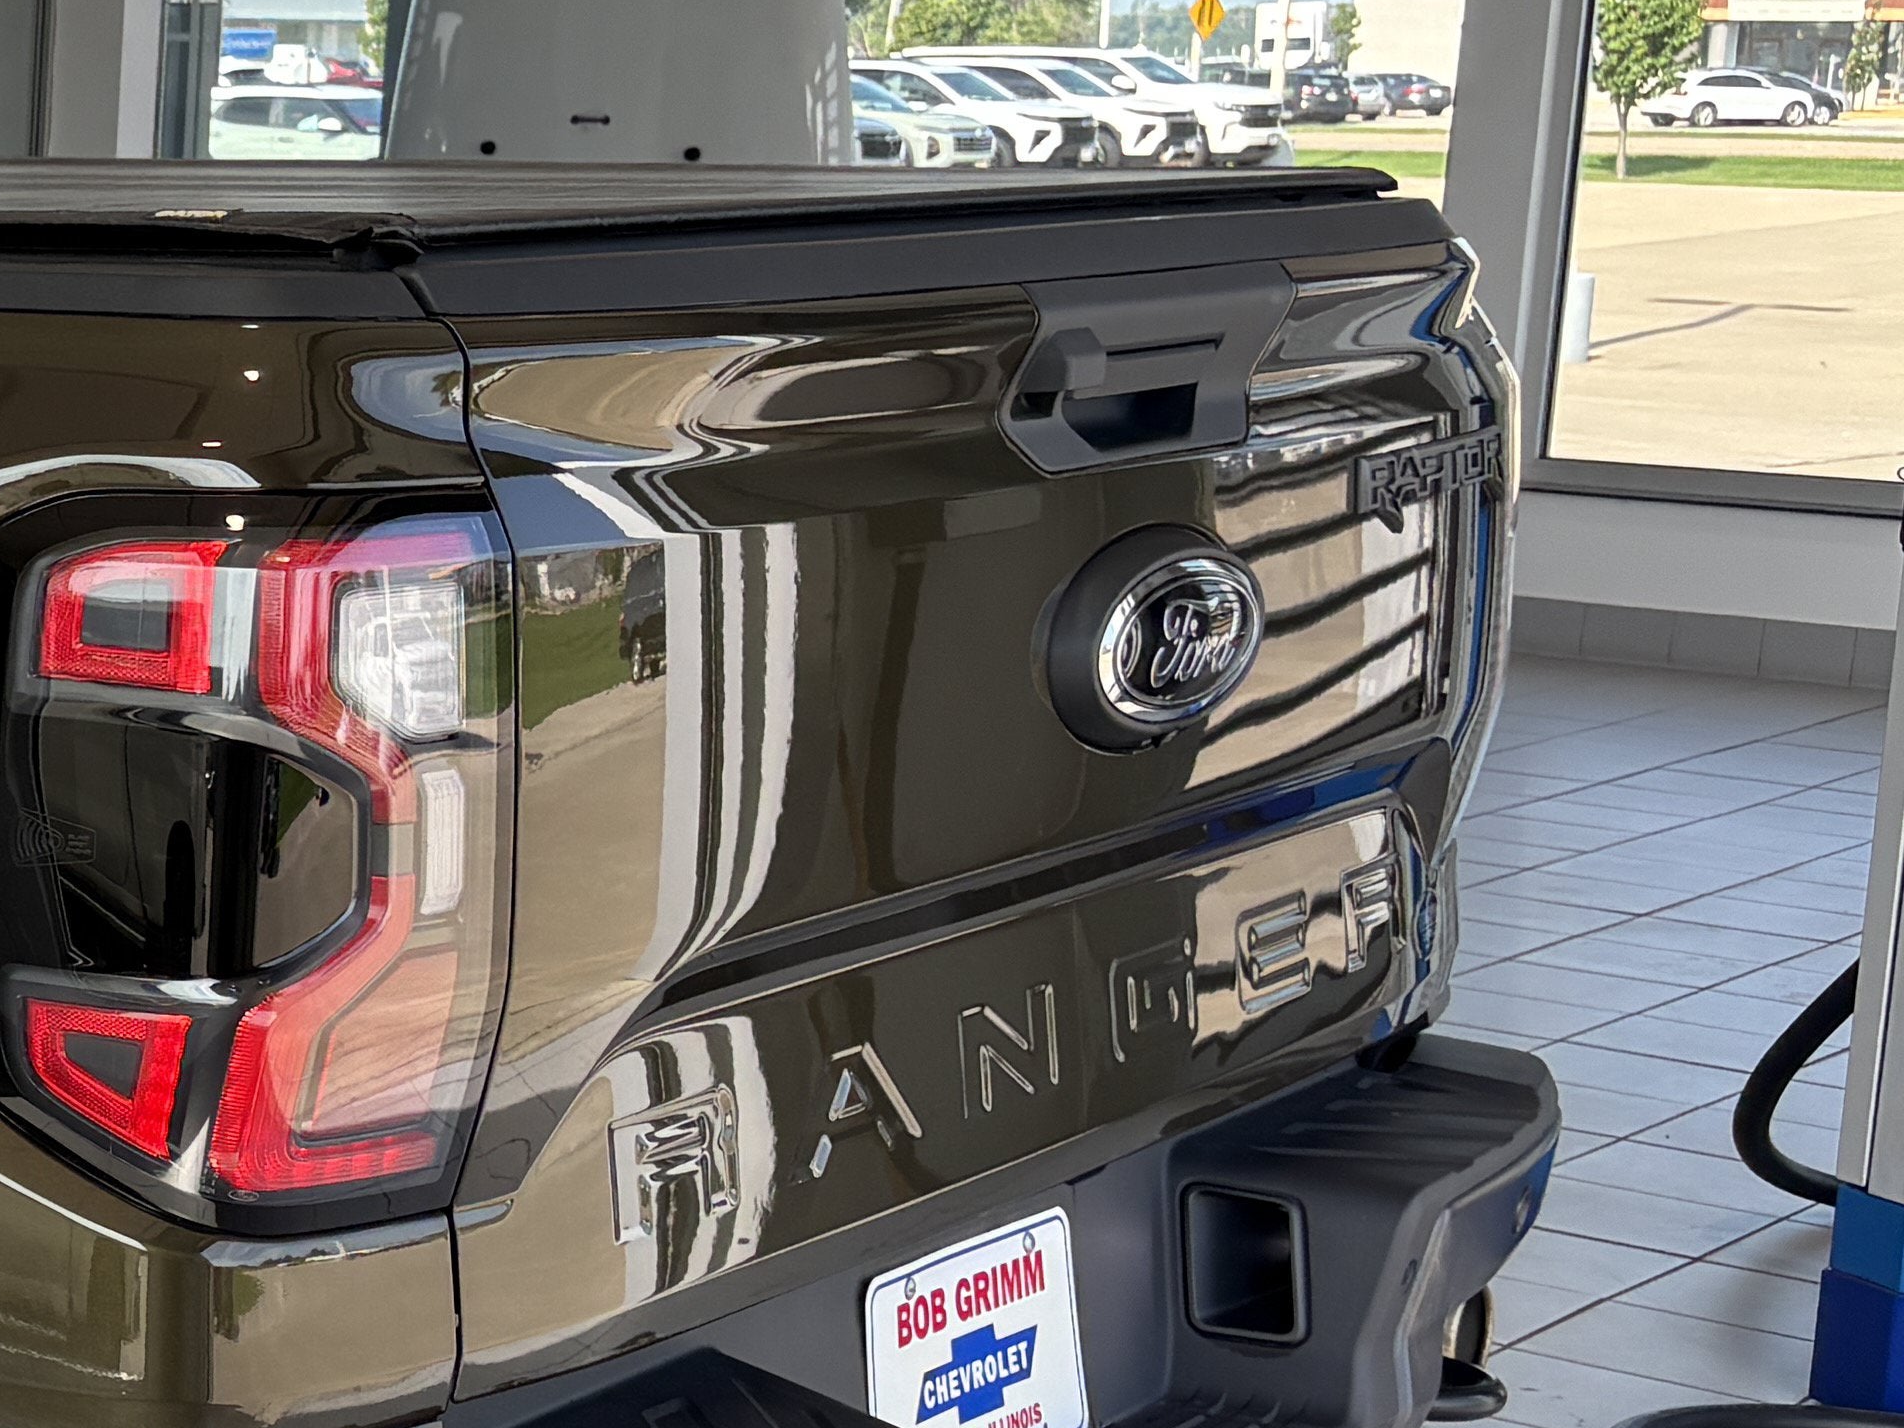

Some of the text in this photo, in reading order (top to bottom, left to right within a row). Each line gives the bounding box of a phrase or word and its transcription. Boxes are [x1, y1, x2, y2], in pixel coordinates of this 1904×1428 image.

[1355, 425, 1505, 534] RAPTOR
[1150, 598, 1240, 689] Ford
[605, 851, 1408, 1246] RANGER
[897, 1249, 1045, 1349] BOB GRIMM
[923, 1340, 1028, 1409] CHEVROLET
